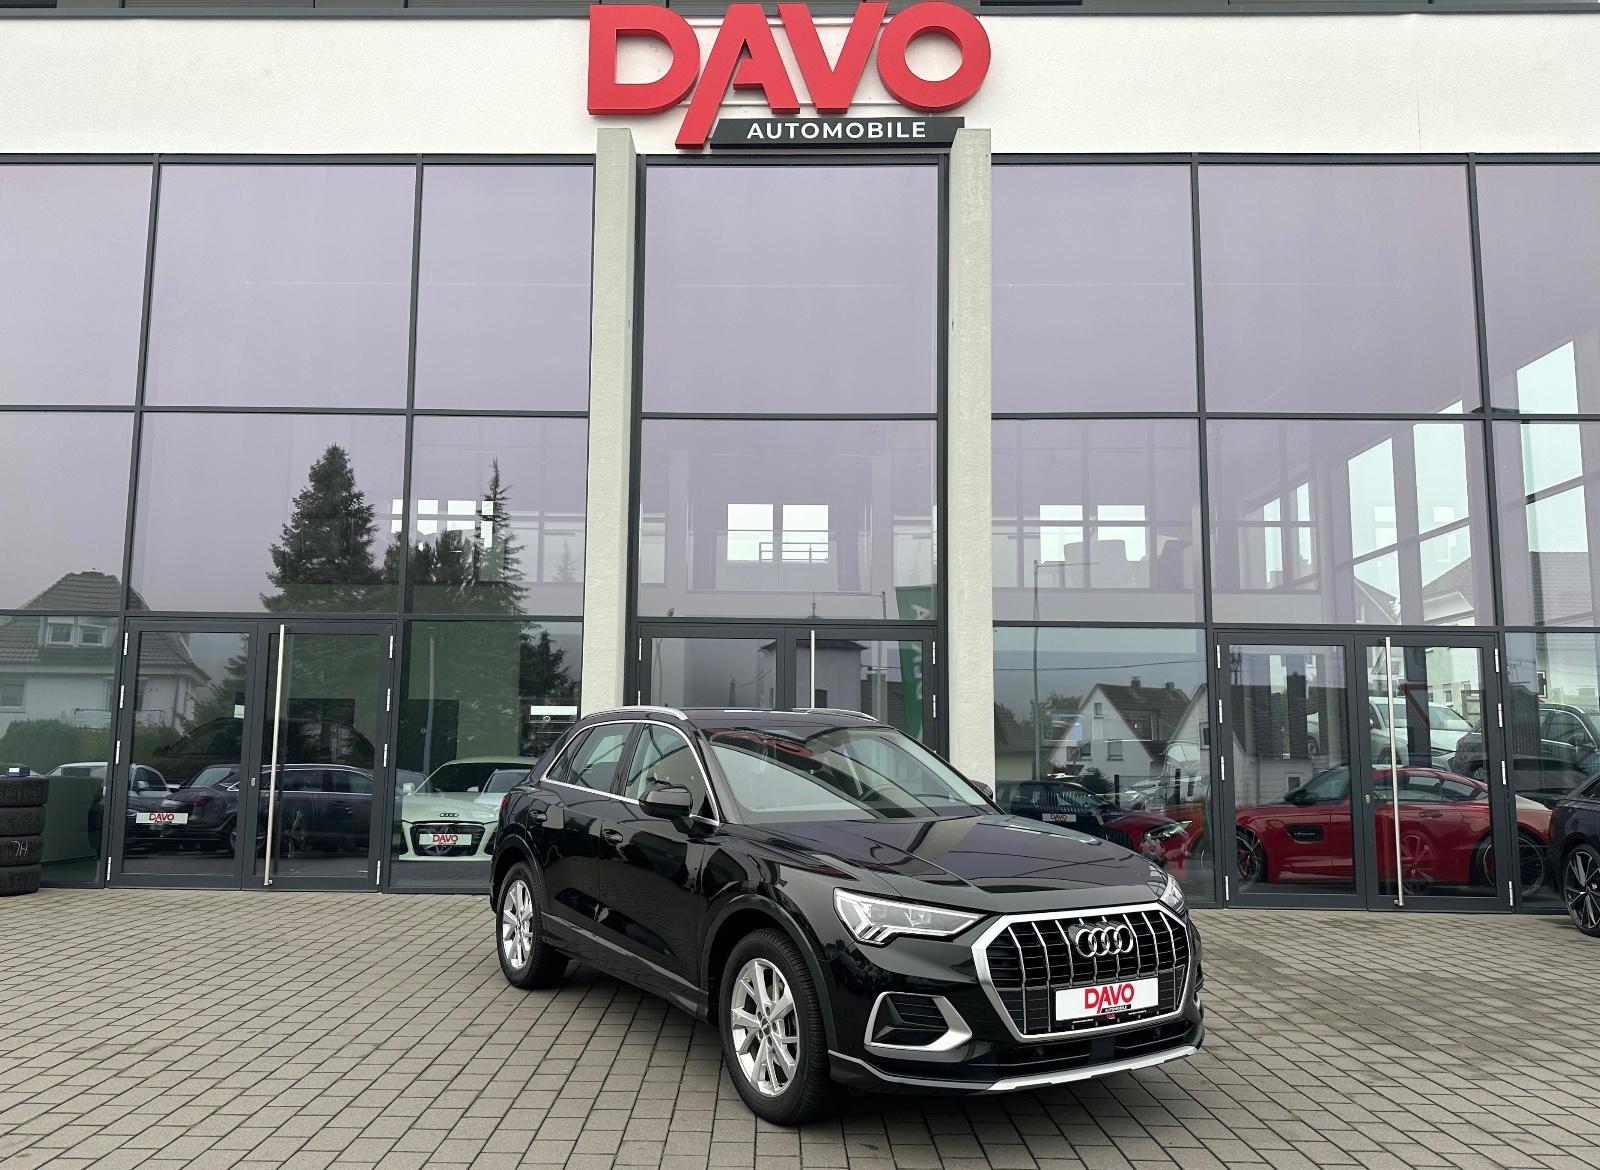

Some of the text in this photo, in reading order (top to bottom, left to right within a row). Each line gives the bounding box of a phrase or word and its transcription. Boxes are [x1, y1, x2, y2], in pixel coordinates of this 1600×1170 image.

[587, 1, 991, 149] DAVO
[746, 121, 927, 140] AUTOMOBILE
[149, 813, 174, 822] DAVO
[432, 834, 458, 843] DAVO
[1085, 983, 1134, 1014] DAVO
